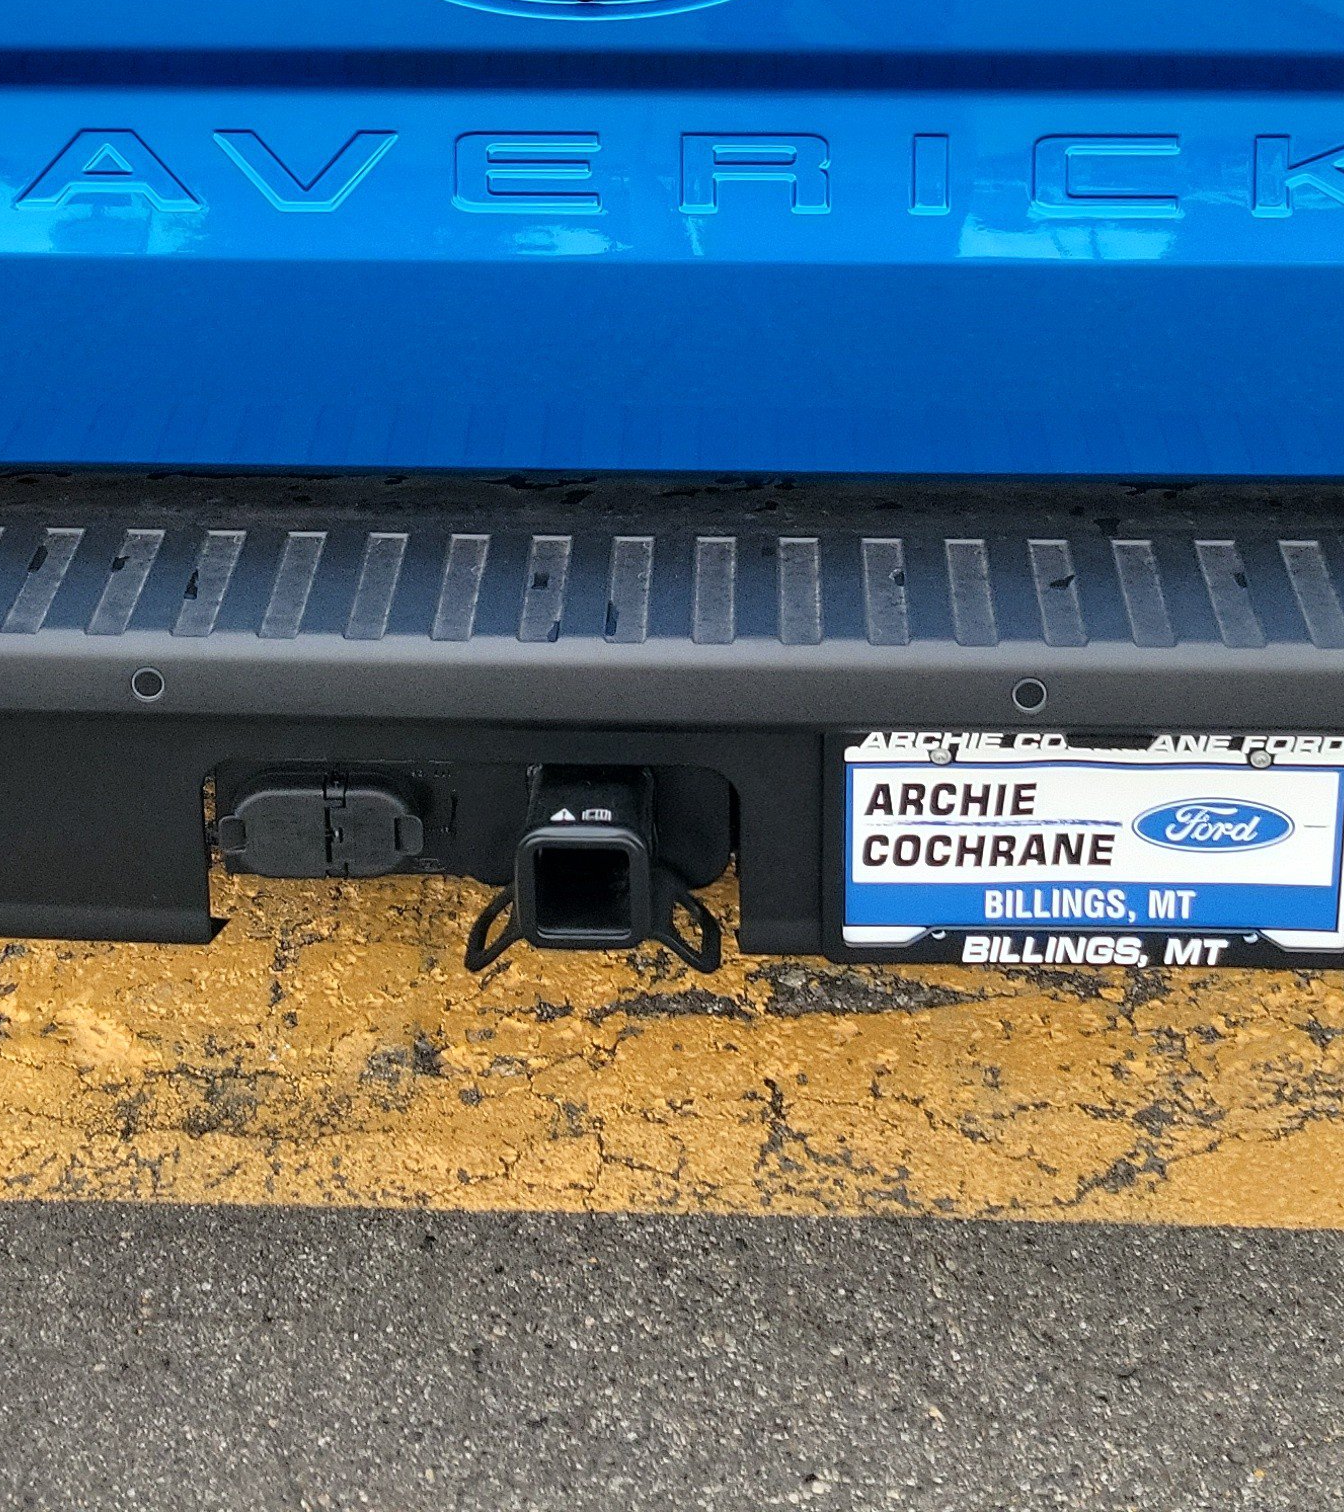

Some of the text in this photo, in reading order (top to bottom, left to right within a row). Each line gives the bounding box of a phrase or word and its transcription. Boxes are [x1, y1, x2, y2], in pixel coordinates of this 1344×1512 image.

[859, 731, 1004, 750] ARCHIE
[863, 782, 1038, 817] ARCHIE
[1164, 804, 1262, 842] Ford
[861, 832, 1116, 868] COCHRANE
[984, 888, 1198, 923] BILLINGS, MT
[961, 935, 1230, 968] BILLINGS, MT
